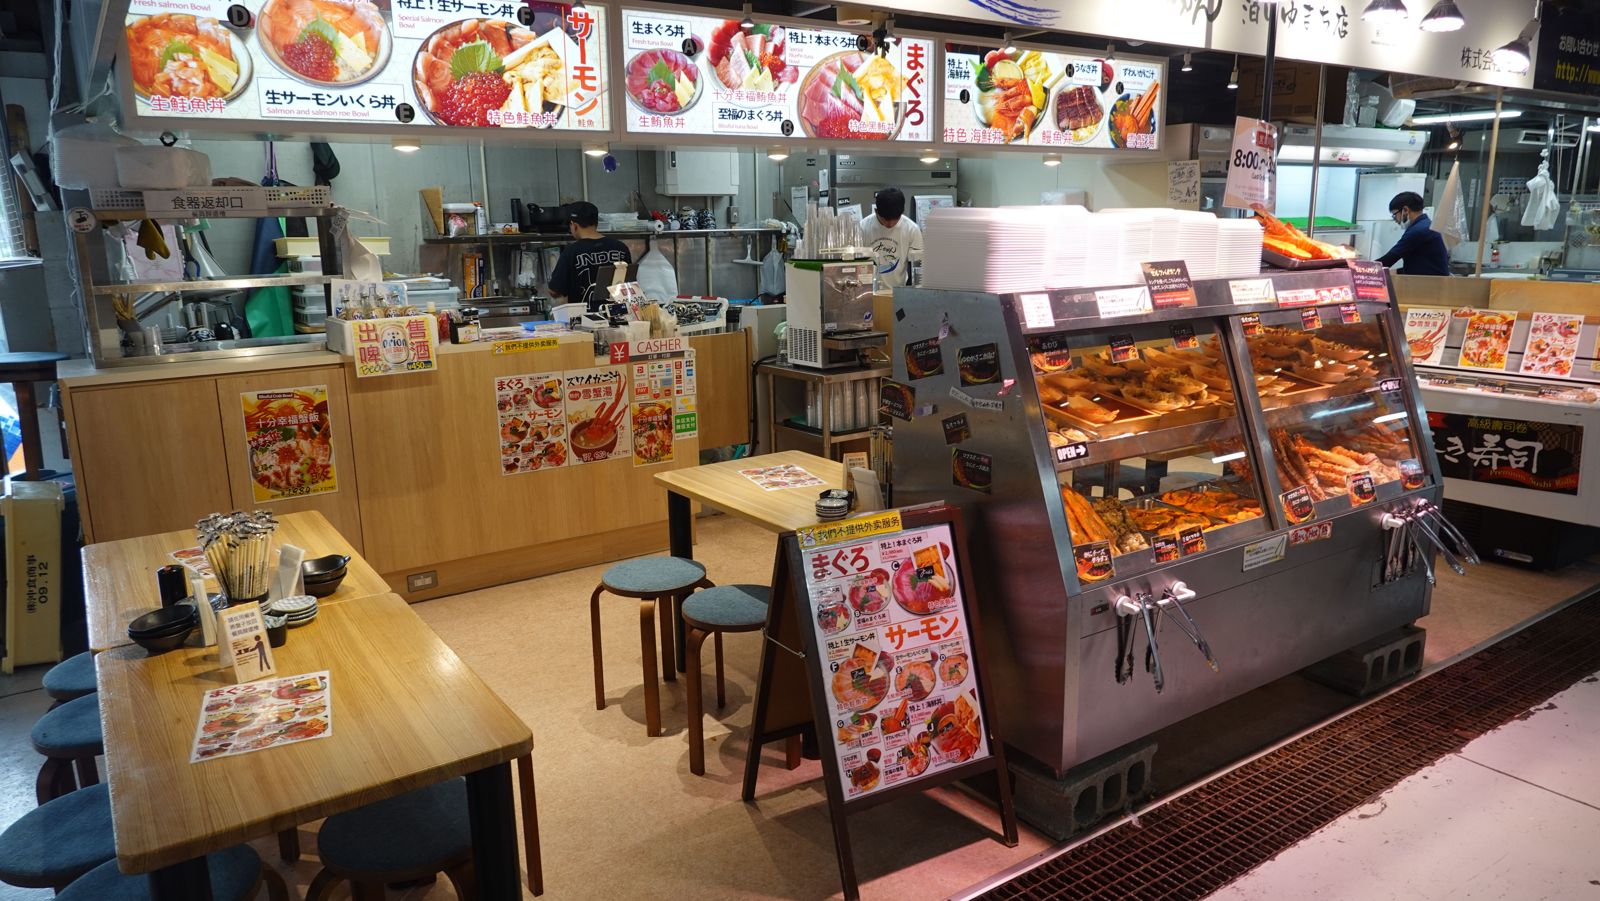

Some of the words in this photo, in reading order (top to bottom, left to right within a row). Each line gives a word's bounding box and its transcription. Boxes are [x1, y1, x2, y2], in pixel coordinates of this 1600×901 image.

[190, 3, 211, 12] Bowl
[632, 21, 685, 38] 生まぐろ丼
[789, 31, 857, 49] 特上！本まぐろ丼
[567, 11, 598, 117] サーモン
[905, 43, 925, 126] まぐろ
[150, 95, 226, 114] 生鮭魚丼
[265, 89, 396, 109] 生サーモンいくら丼
[266, 107, 294, 116] Salmon
[297, 108, 309, 116] and
[944, 128, 967, 143] 特色
[171, 196, 244, 210] 食器返却口
[409, 340, 432, 362] 酒
[636, 338, 682, 353] CASHER
[497, 378, 524, 392] まぐろ
[527, 408, 562, 421] サーモン
[1057, 446, 1077, 462] OPEN
[1433, 432, 1543, 474] き寿司
[811, 546, 870, 580] まぐろ
[38, 561, 48, 604] 09.12
[885, 615, 960, 651] サーモン
